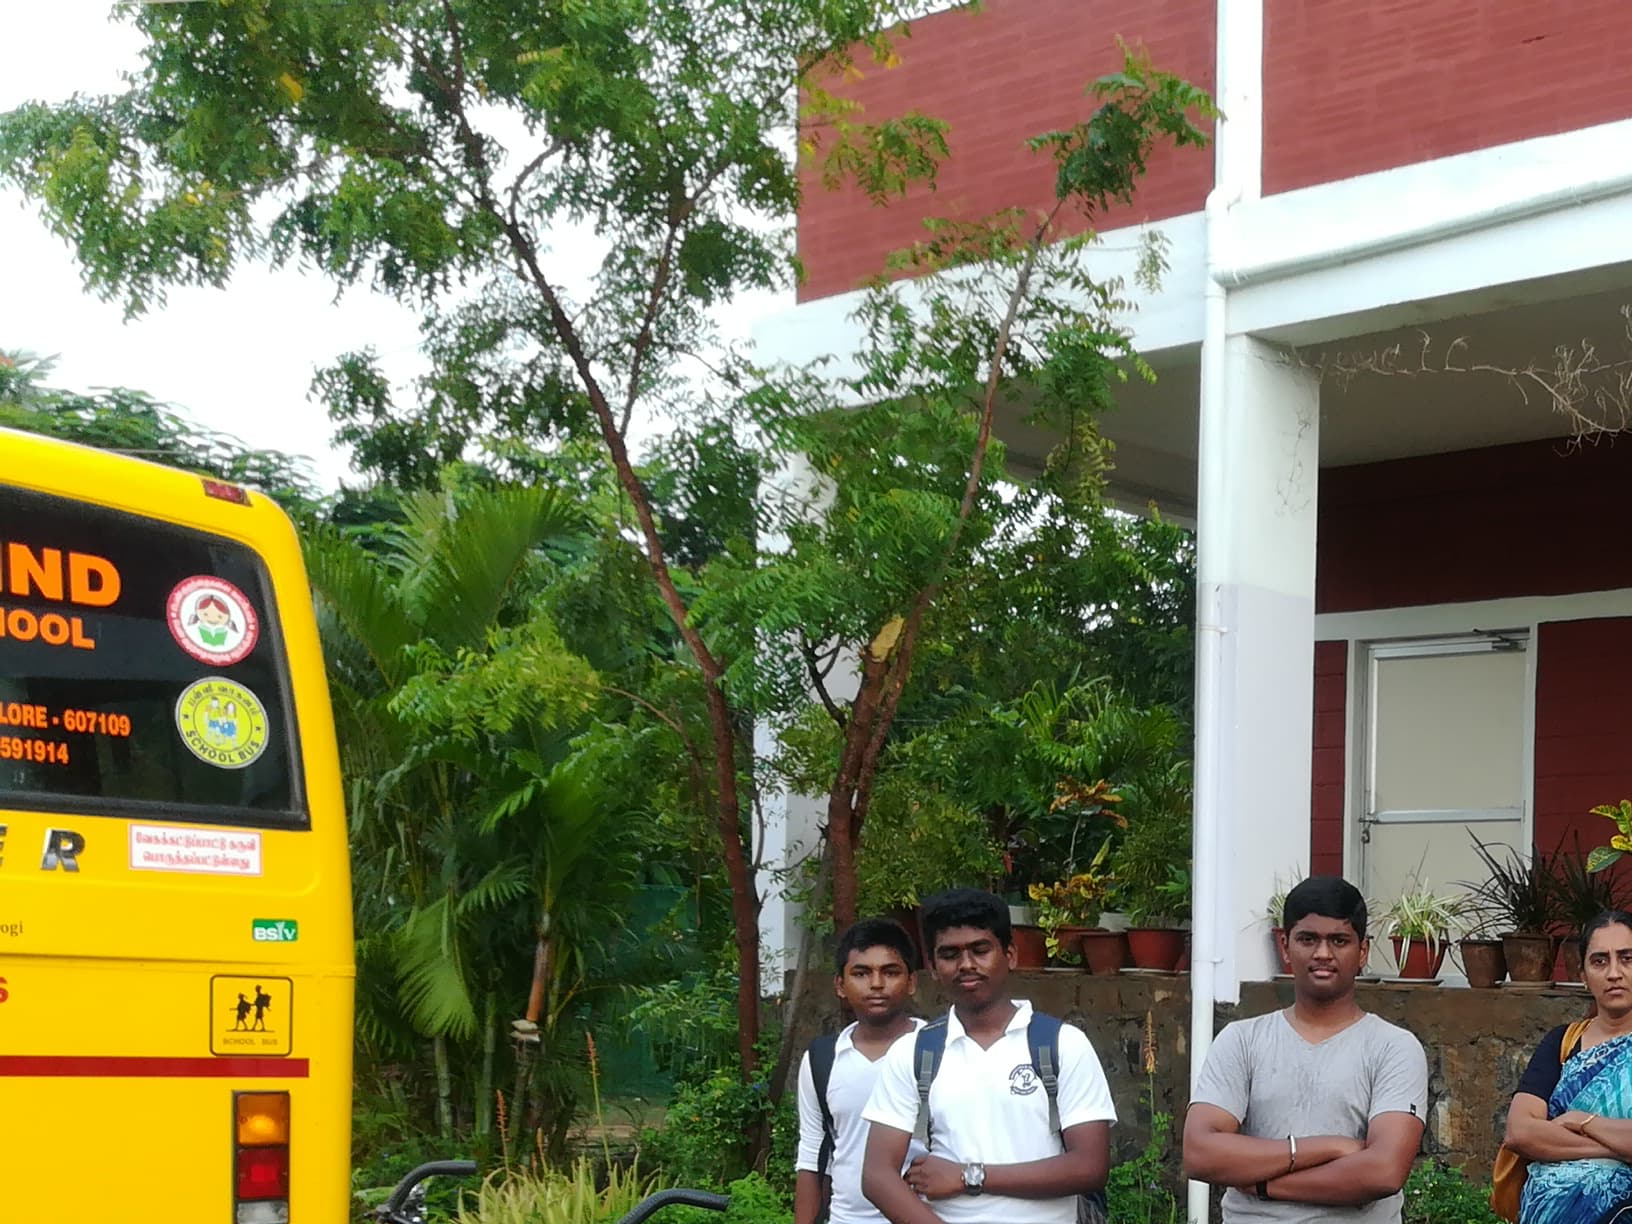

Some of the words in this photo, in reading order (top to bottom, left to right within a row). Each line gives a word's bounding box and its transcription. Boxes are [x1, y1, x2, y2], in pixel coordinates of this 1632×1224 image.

[0, 541, 121, 607] ND
[63, 708, 131, 737] 607109
[186, 730, 236, 763] SCHOOL
[238, 740, 260, 761] BUS
